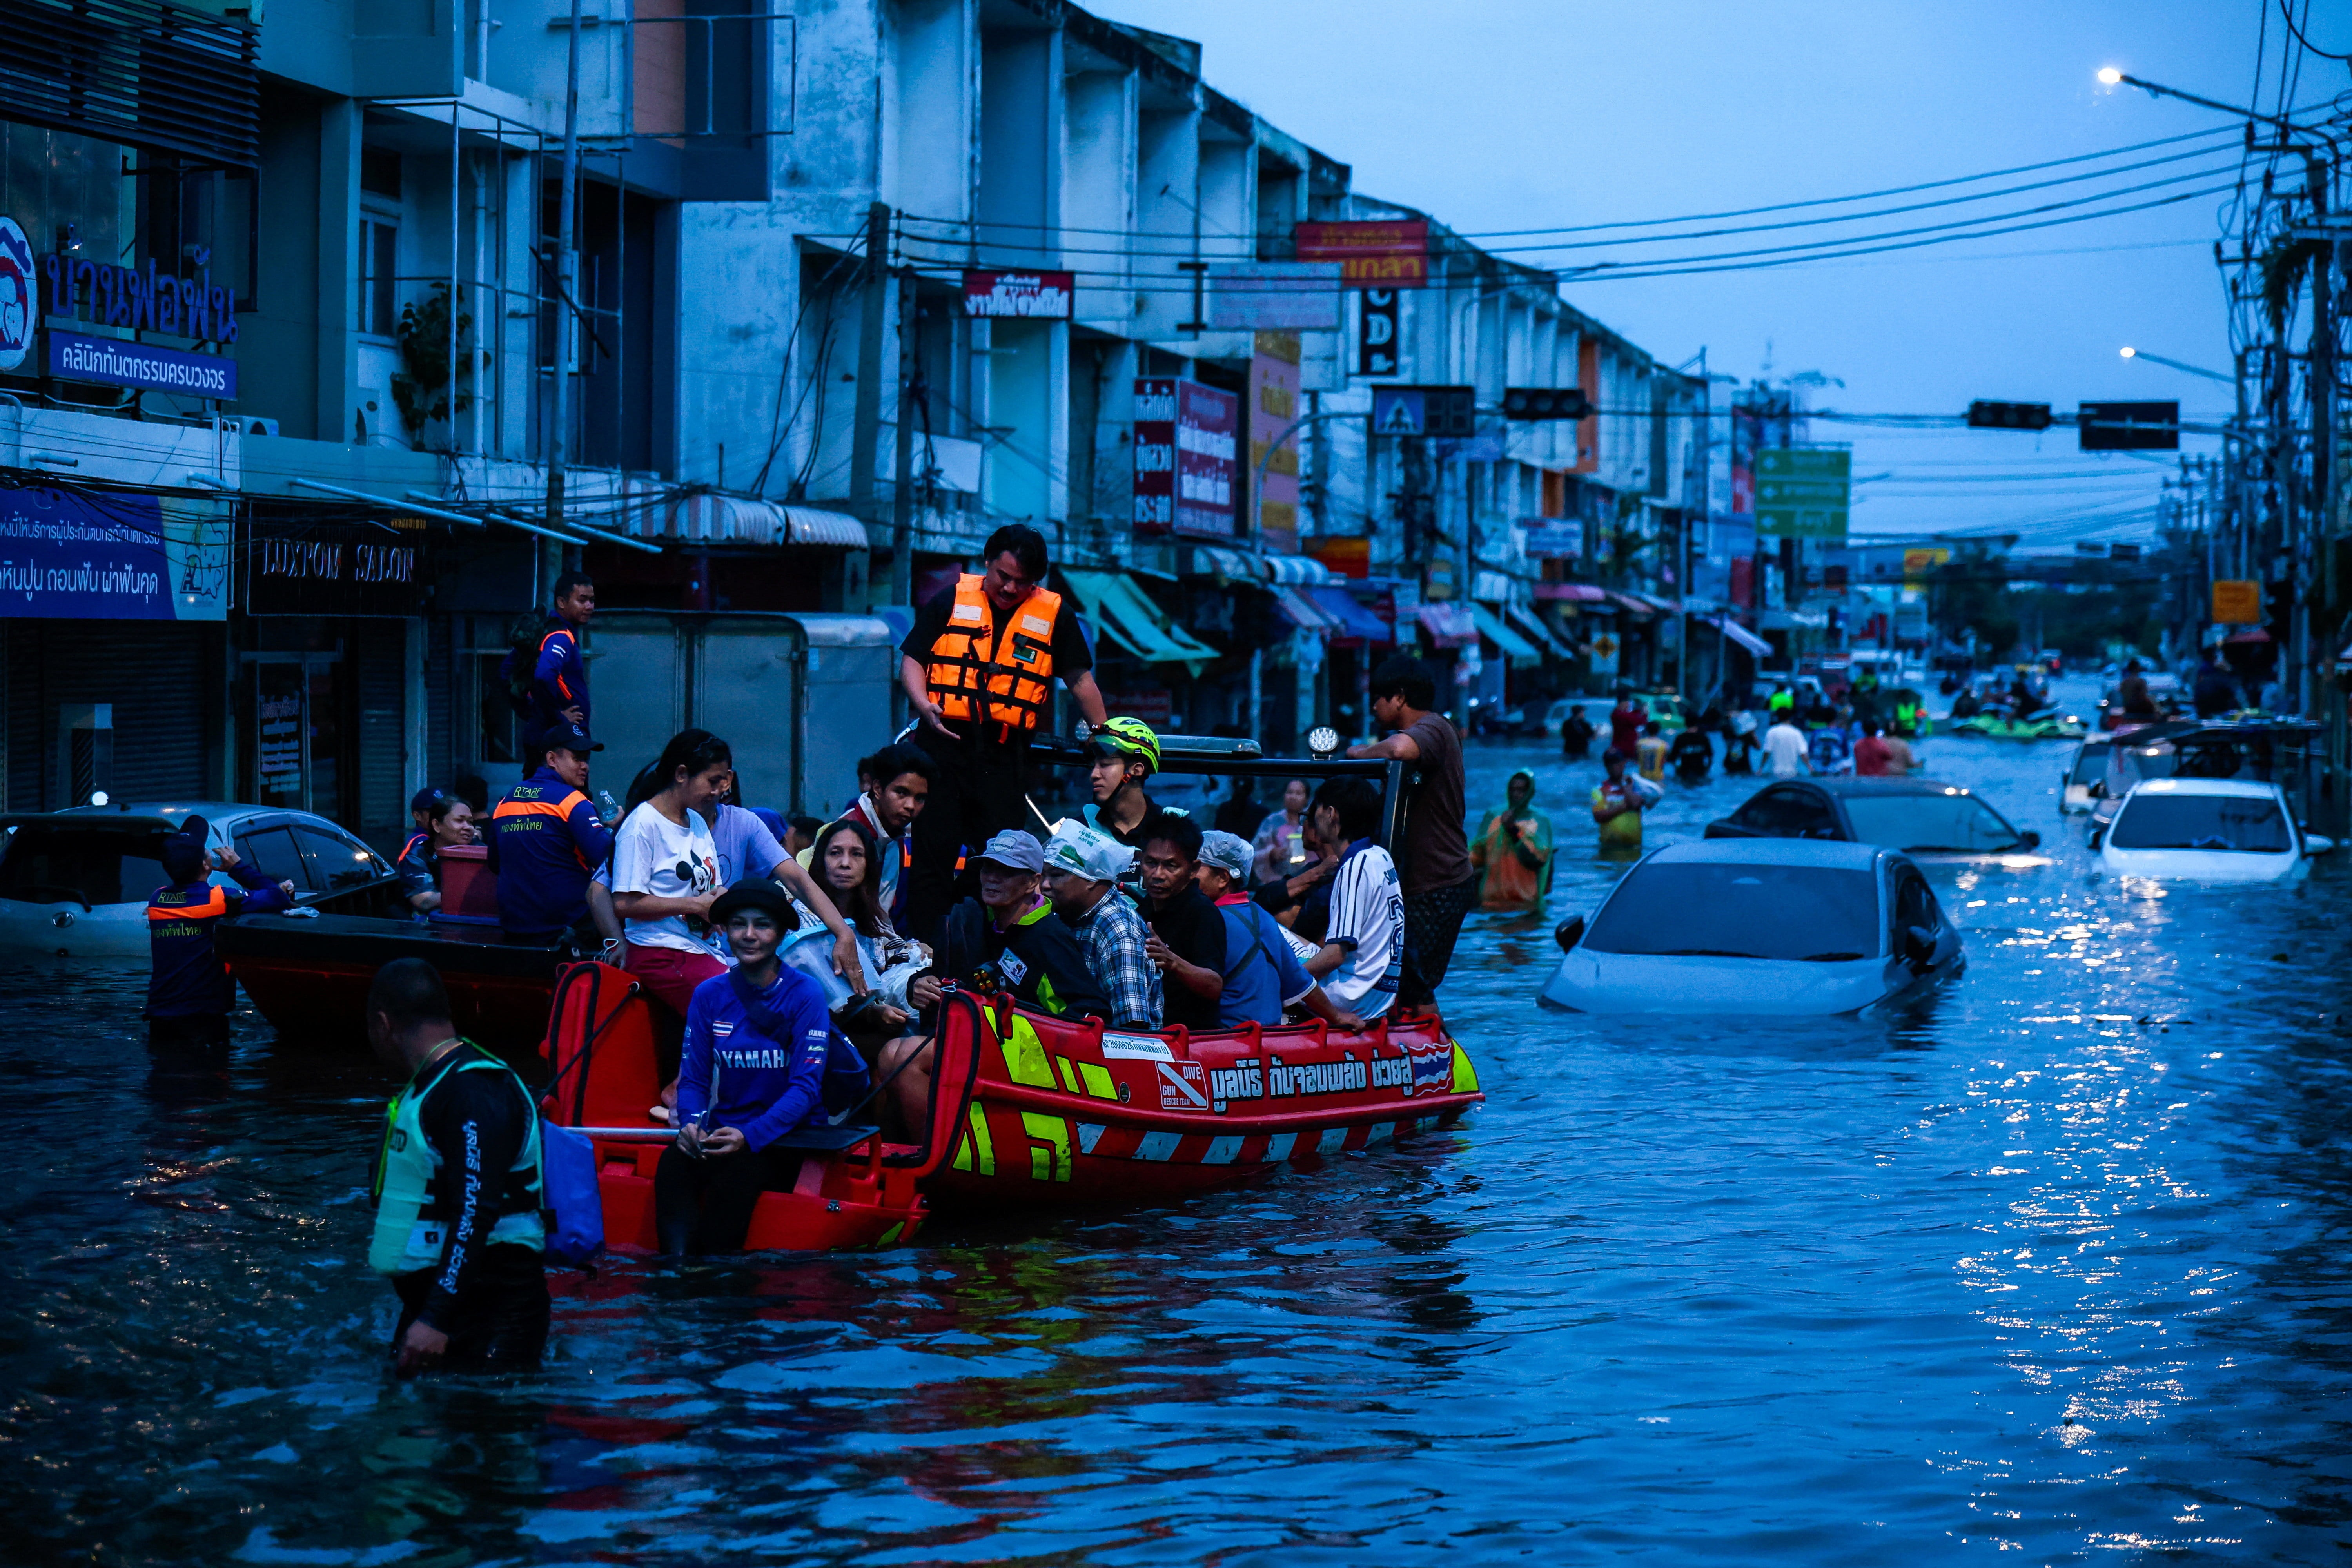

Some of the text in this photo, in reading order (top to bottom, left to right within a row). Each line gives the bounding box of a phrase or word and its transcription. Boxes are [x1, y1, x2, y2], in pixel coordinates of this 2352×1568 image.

[47, 223, 239, 342] บ้านฟอฟัน
[63, 343, 225, 390] คลินิกทันตกรรมครบวงจร
[0, 559, 158, 604] หินปูน ถอนฟัน ผ่าฟันคุด
[356, 544, 414, 582] SALON
[514, 786, 543, 797] RTARF
[158, 892, 187, 902] RTARF
[1162, 1085, 1176, 1096] GUN
[1182, 1066, 1201, 1080] DIVE
[1210, 1044, 1414, 1112] มูลนิธิ กันจอมพลัง ช่วยสู้
